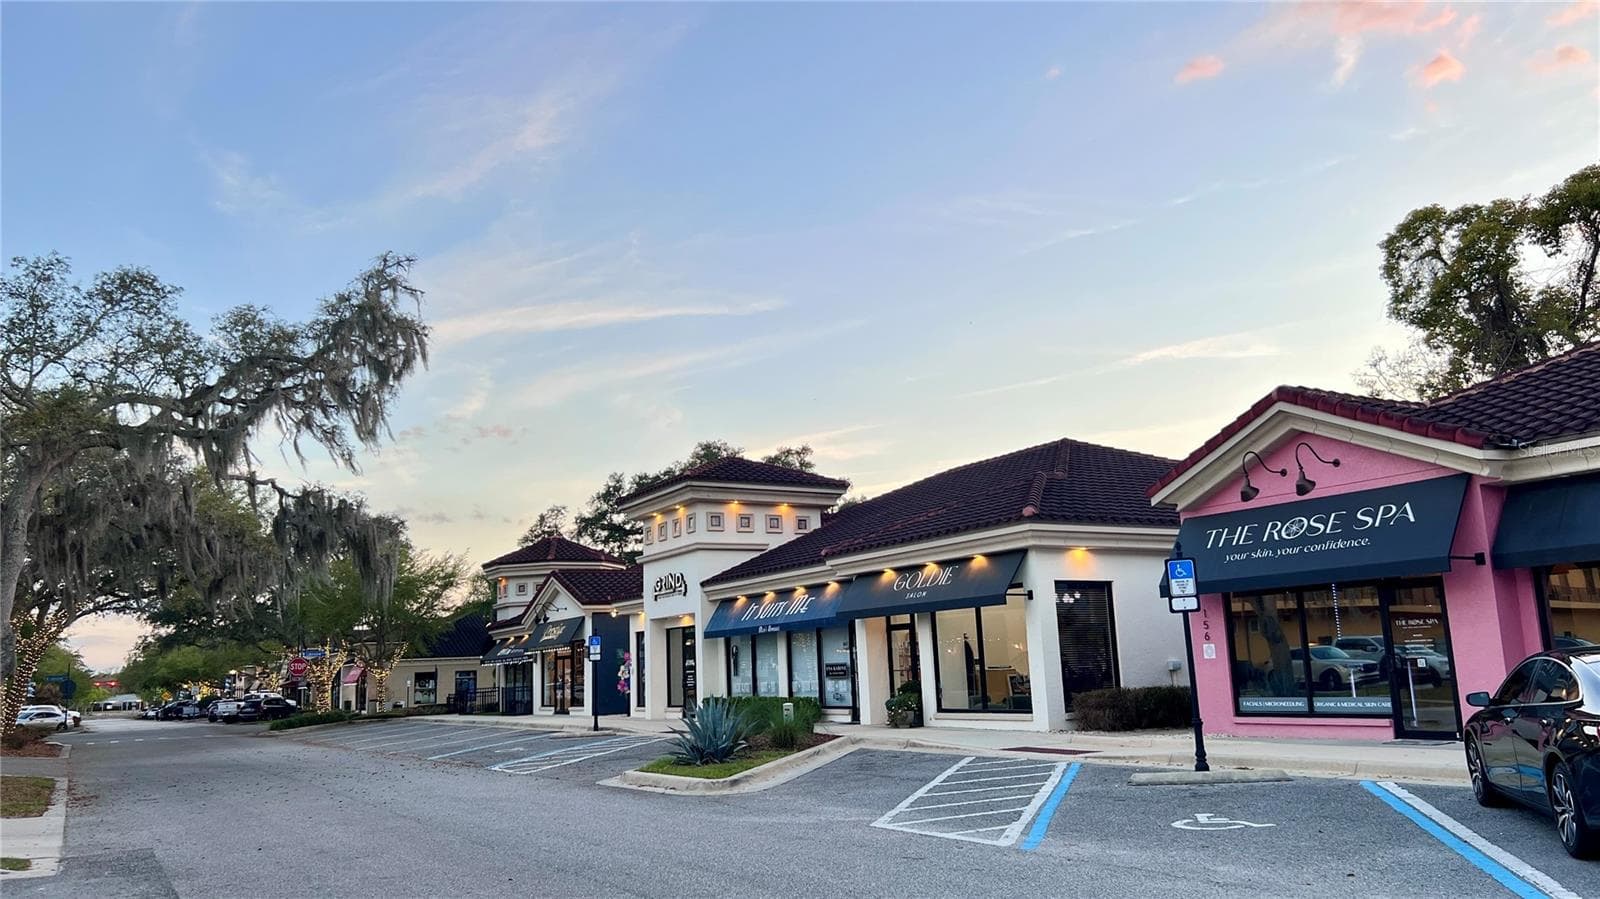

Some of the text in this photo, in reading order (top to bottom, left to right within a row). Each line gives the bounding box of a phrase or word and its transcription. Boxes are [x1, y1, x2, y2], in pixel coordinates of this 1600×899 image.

[1206, 501, 1416, 549] THE ROSE SPA
[1223, 551, 1250, 563] your
[1275, 545, 1303, 559] your
[1303, 536, 1371, 553] confidence.
[893, 565, 959, 591] GOLDIE
[754, 600, 788, 620] SUITS
[785, 594, 816, 616] ME
[290, 662, 307, 670] STOP
